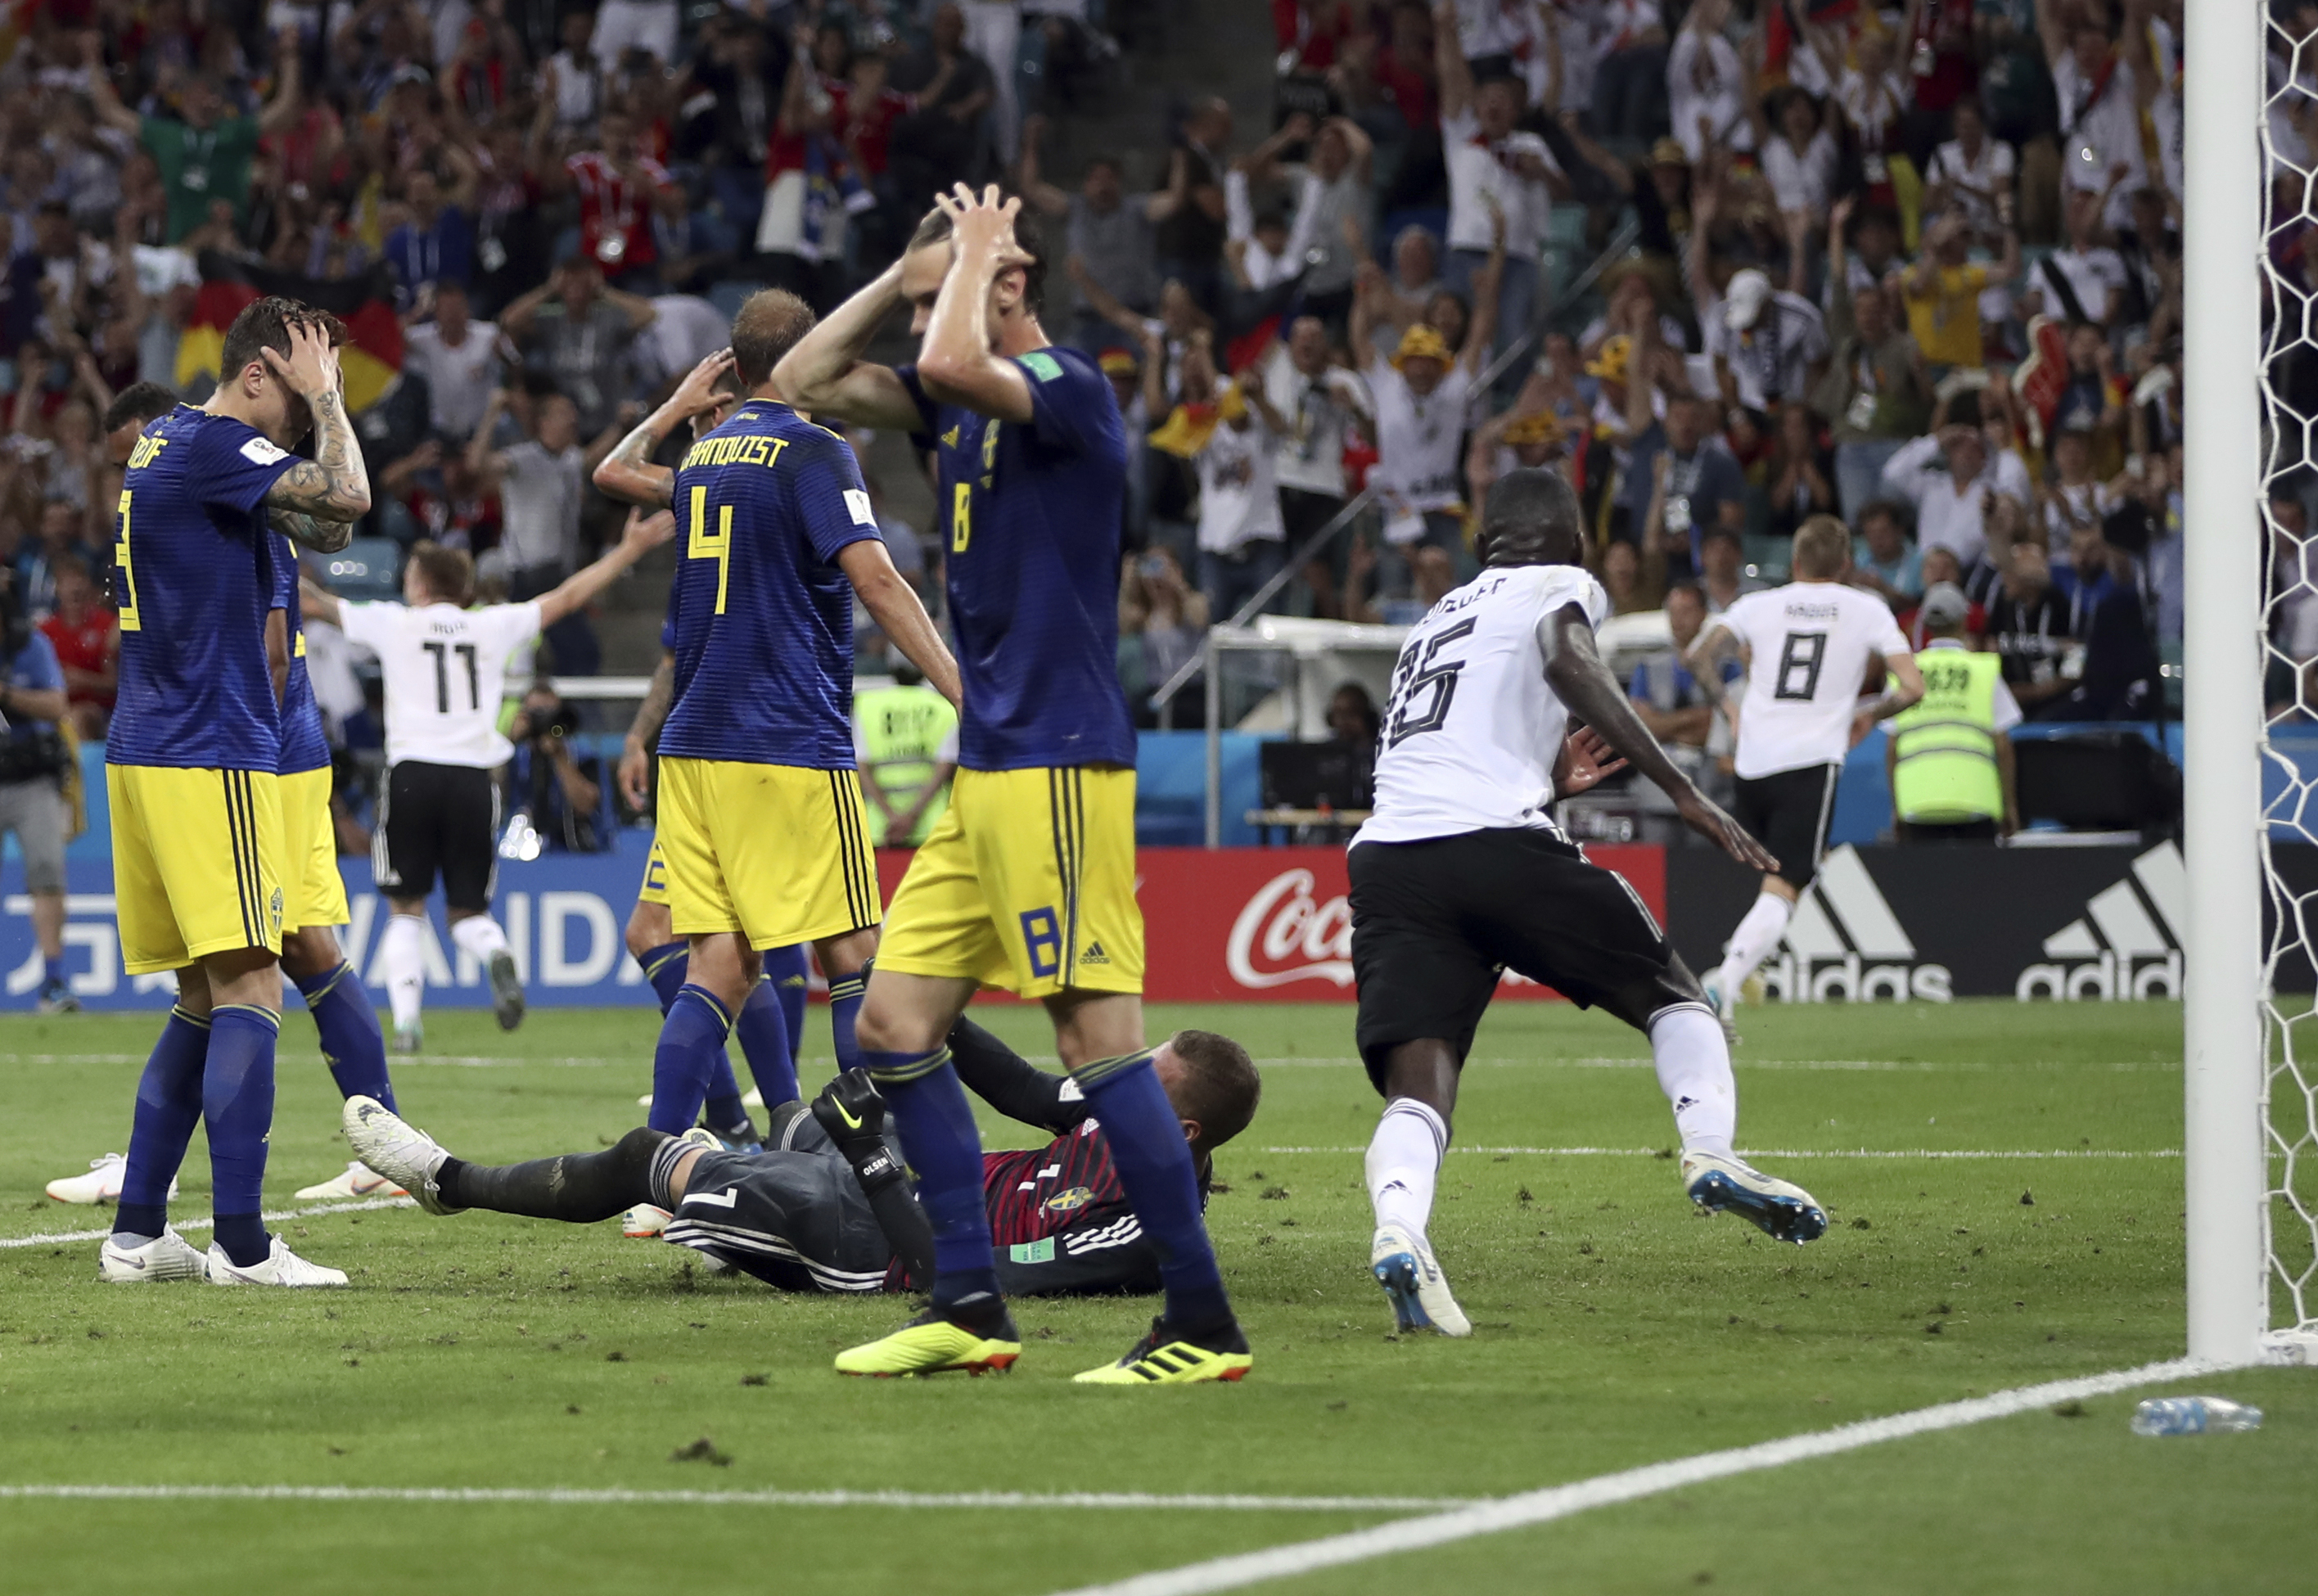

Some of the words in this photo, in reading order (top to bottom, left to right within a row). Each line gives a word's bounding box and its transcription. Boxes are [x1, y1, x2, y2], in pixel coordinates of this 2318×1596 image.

[688, 485, 733, 615] 4
[953, 482, 971, 552] 8
[423, 642, 478, 713] 11
[1775, 633, 1827, 699] 8
[282, 890, 645, 988] AND
[1019, 905, 1062, 978] 8
[1699, 949, 1954, 1004] didas
[2014, 949, 2183, 1003] adid
[863, 1156, 889, 1176] OLSEN
